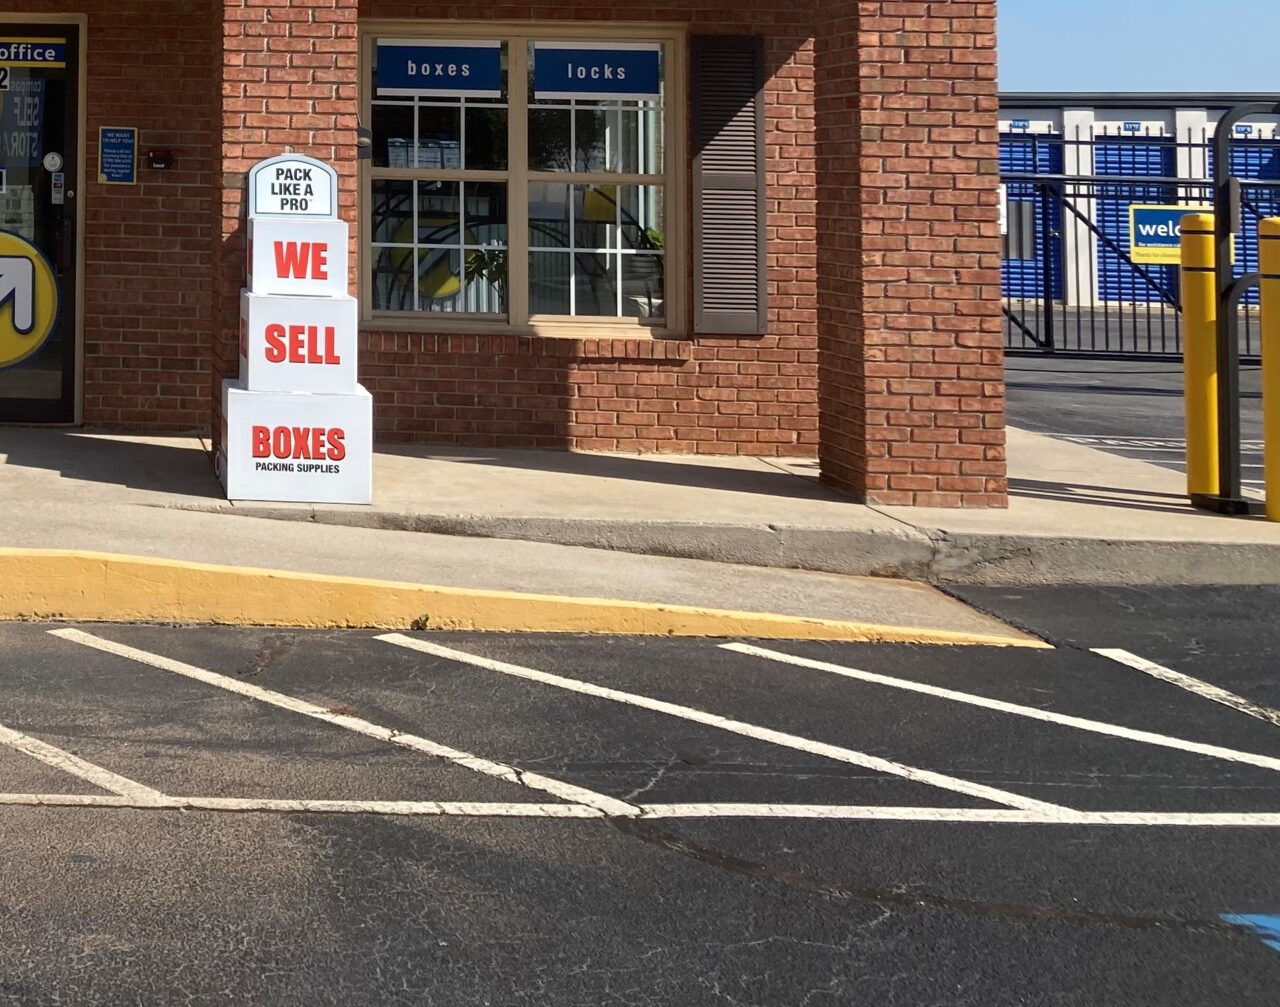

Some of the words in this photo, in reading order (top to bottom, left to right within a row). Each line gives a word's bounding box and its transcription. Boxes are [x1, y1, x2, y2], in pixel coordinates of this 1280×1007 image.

[407, 60, 470, 76] boxes
[567, 63, 625, 79] locks
[276, 168, 312, 181] PACK
[271, 182, 301, 196] LIKE
[304, 183, 313, 196] A
[1138, 220, 1182, 236] welc
[274, 241, 328, 280] WE
[265, 323, 341, 365] SELL
[252, 425, 346, 461] BOXES
[255, 462, 294, 472] PACKING
[296, 463, 340, 474] SUPPLIES
